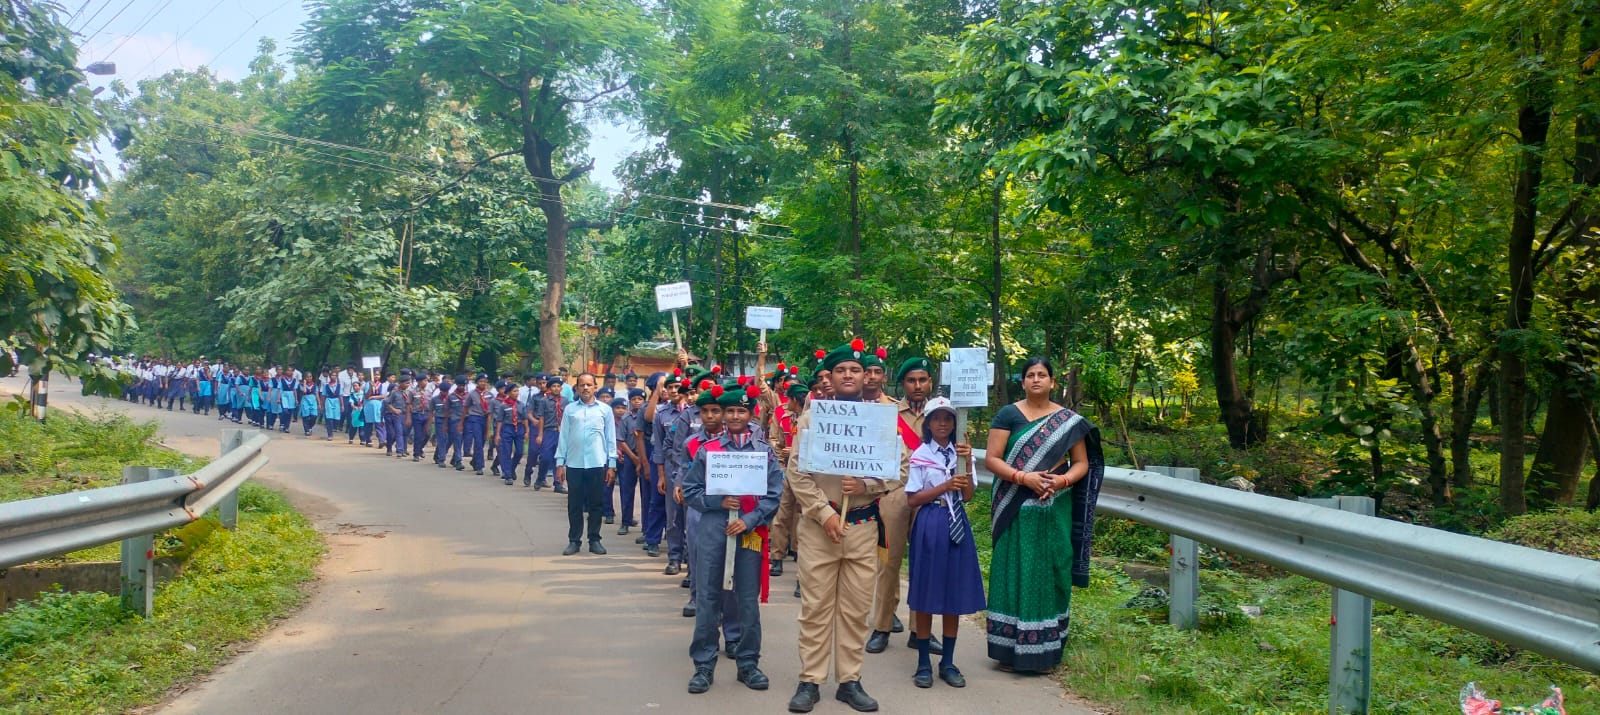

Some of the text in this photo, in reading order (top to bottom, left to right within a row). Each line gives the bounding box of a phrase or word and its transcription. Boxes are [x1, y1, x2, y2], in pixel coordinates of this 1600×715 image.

[816, 402, 858, 416] NASA
[817, 422, 867, 437] MUKT
[824, 443, 875, 455] BHARAT
[831, 460, 884, 472] ABHIYAN
